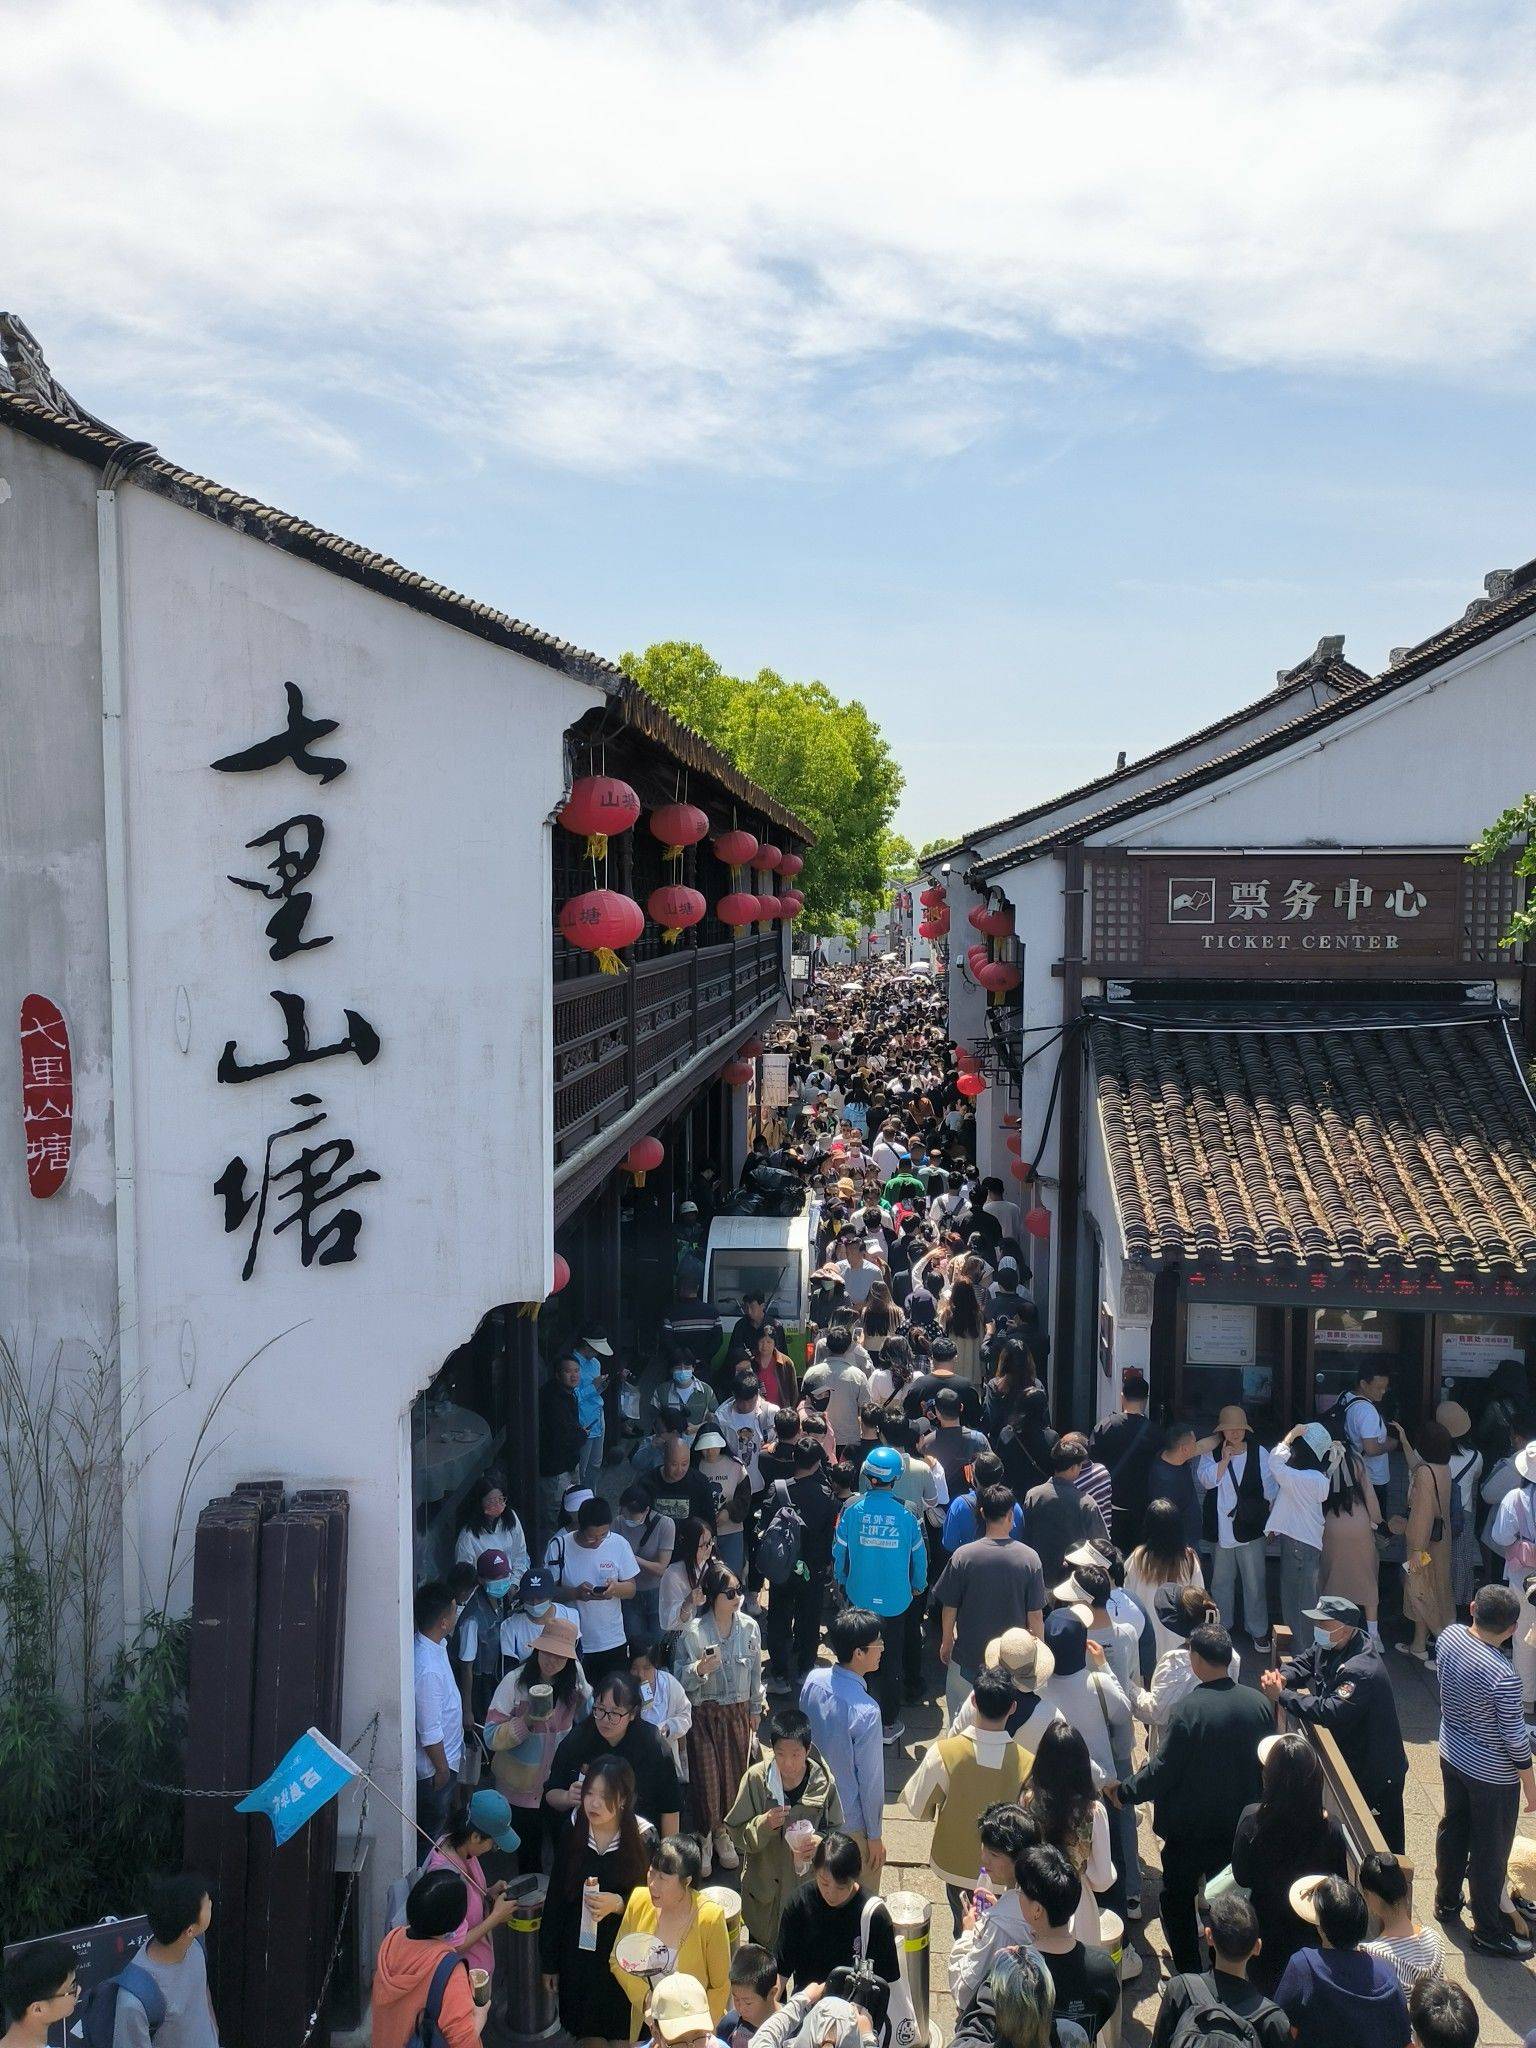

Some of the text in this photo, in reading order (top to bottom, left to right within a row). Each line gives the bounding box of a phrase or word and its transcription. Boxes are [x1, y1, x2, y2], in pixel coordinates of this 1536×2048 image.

[663, 903, 694, 916] 山塘
[1228, 878, 1428, 921] 票务中心
[1201, 934, 1401, 949] TICKET CENTER
[210, 681, 381, 1280] 七里山塘
[20, 1017, 73, 1176] 七里山塘
